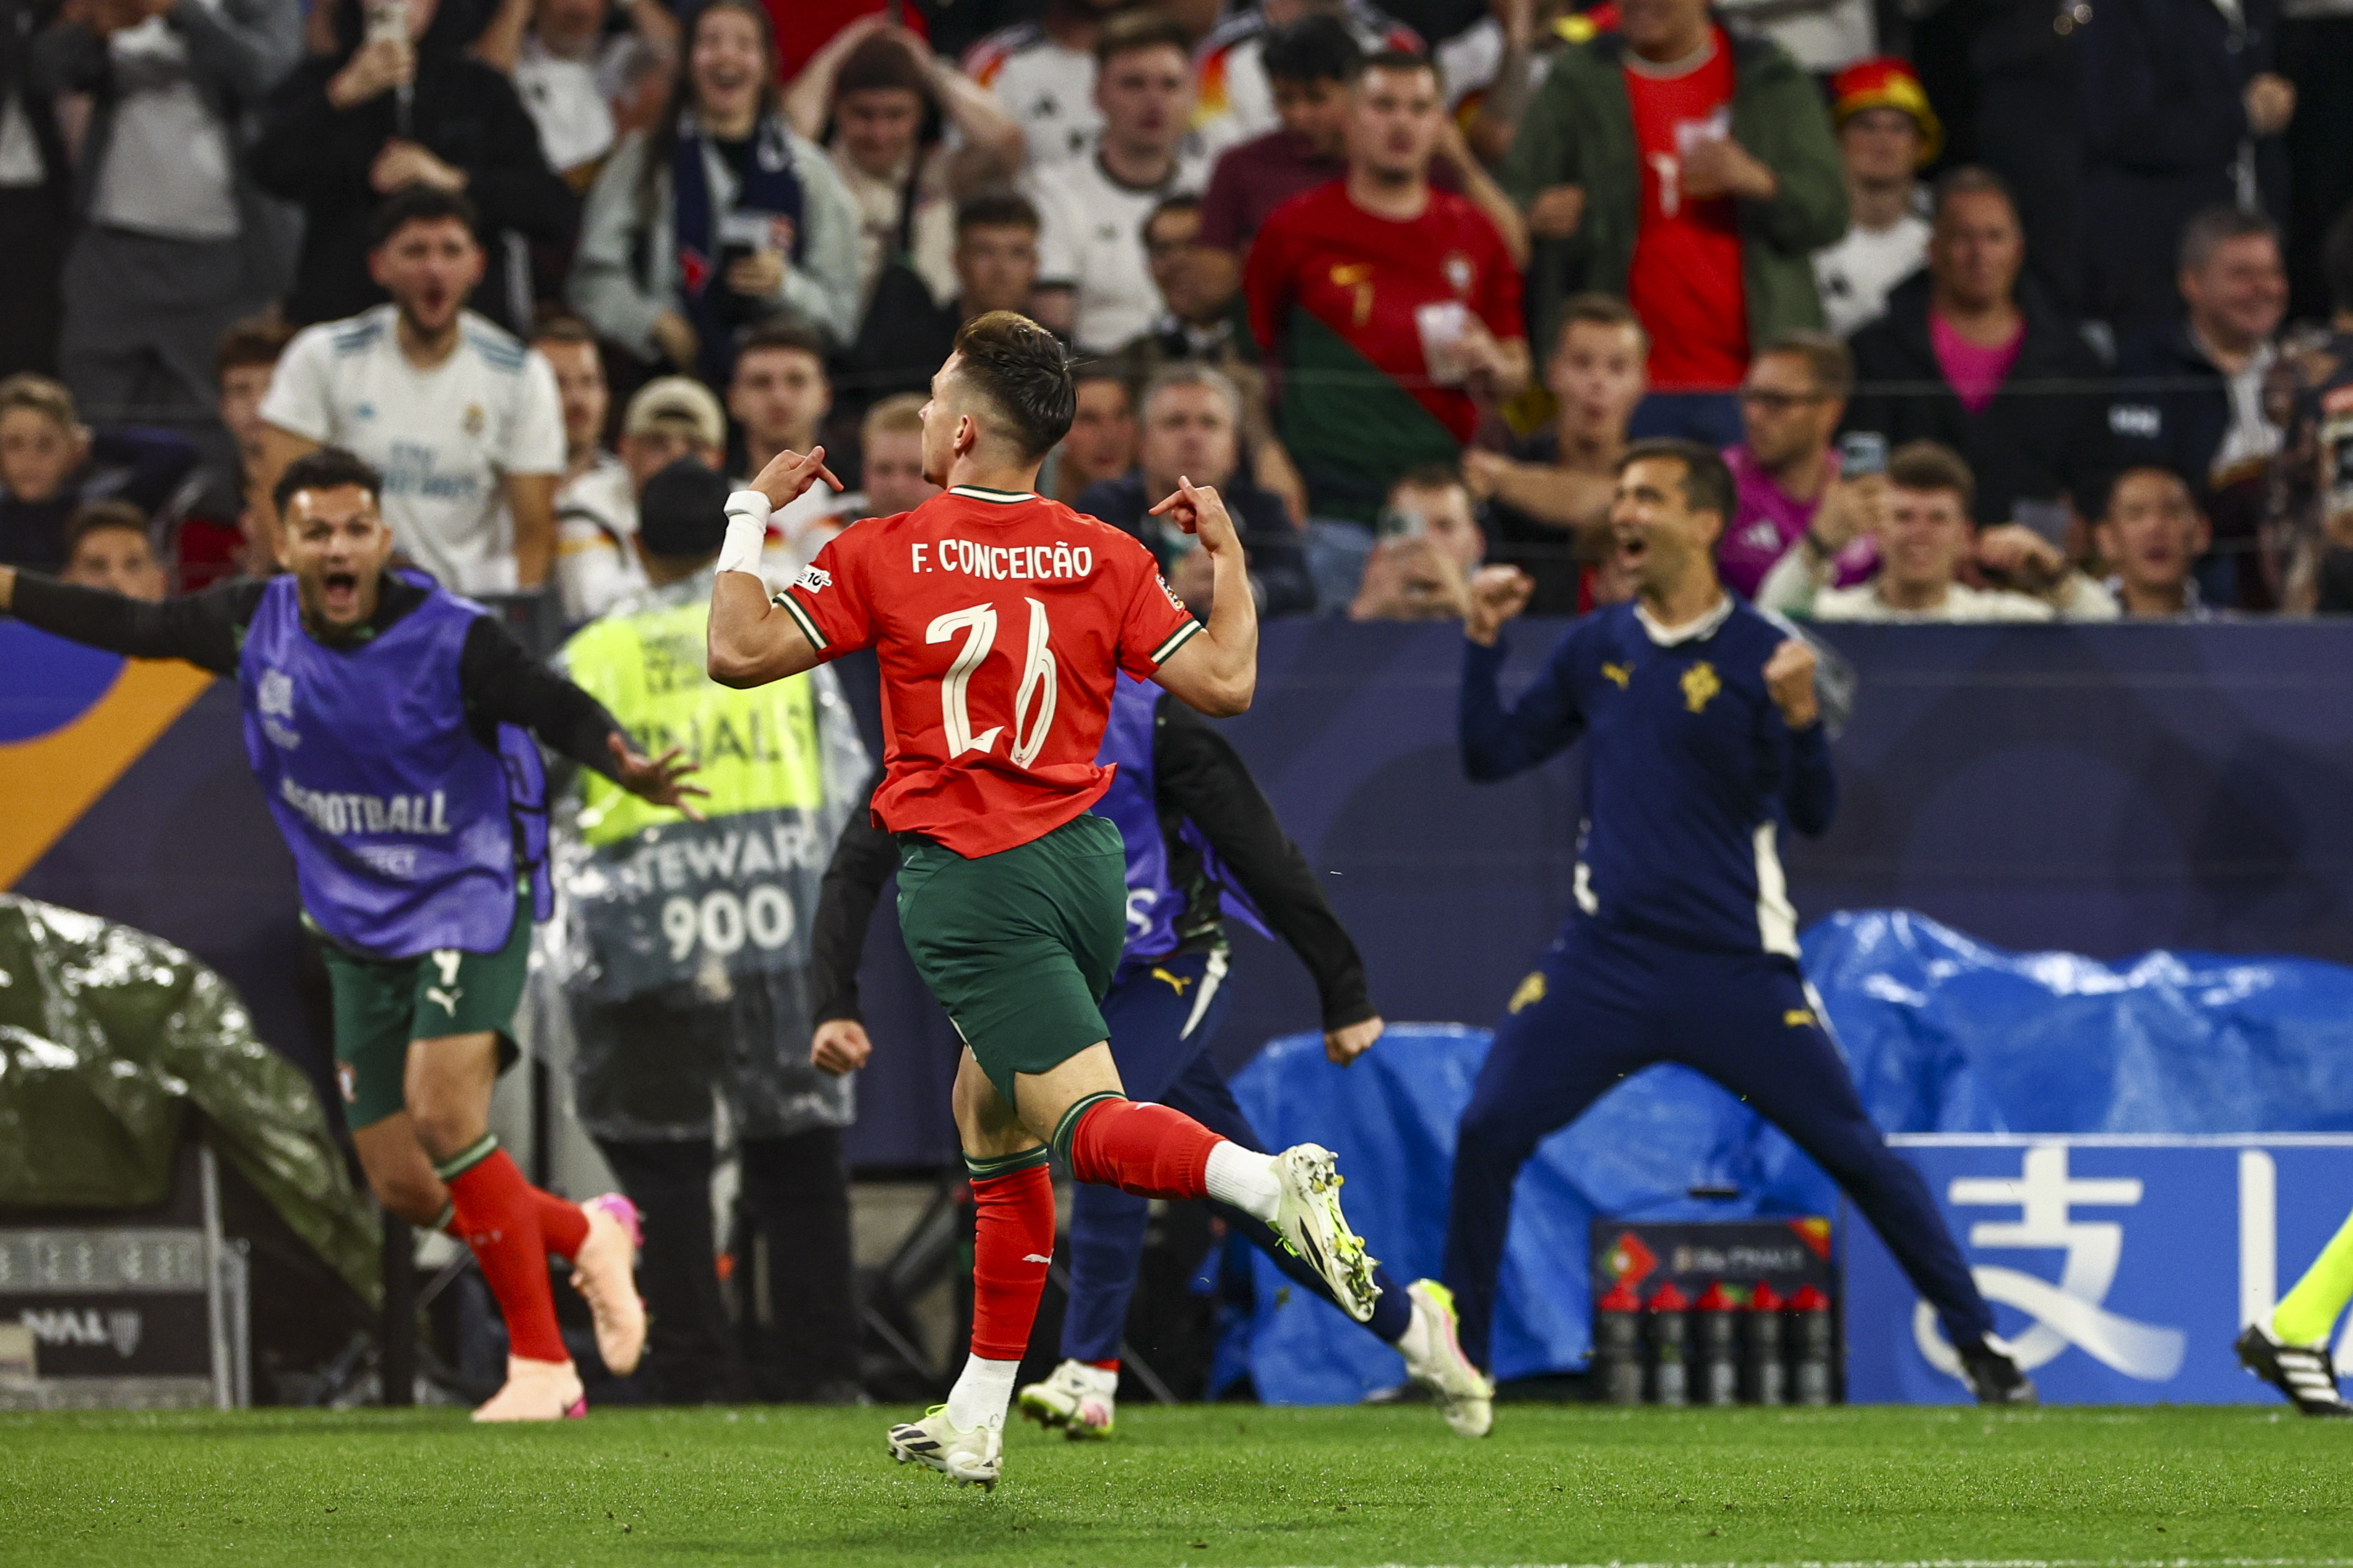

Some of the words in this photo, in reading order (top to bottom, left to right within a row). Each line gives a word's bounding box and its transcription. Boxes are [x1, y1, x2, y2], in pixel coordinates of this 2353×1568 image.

[911, 543, 932, 573] F.
[925, 596, 1057, 770] 26
[661, 883, 796, 962] 900
[1913, 1138, 2186, 1382] 支
